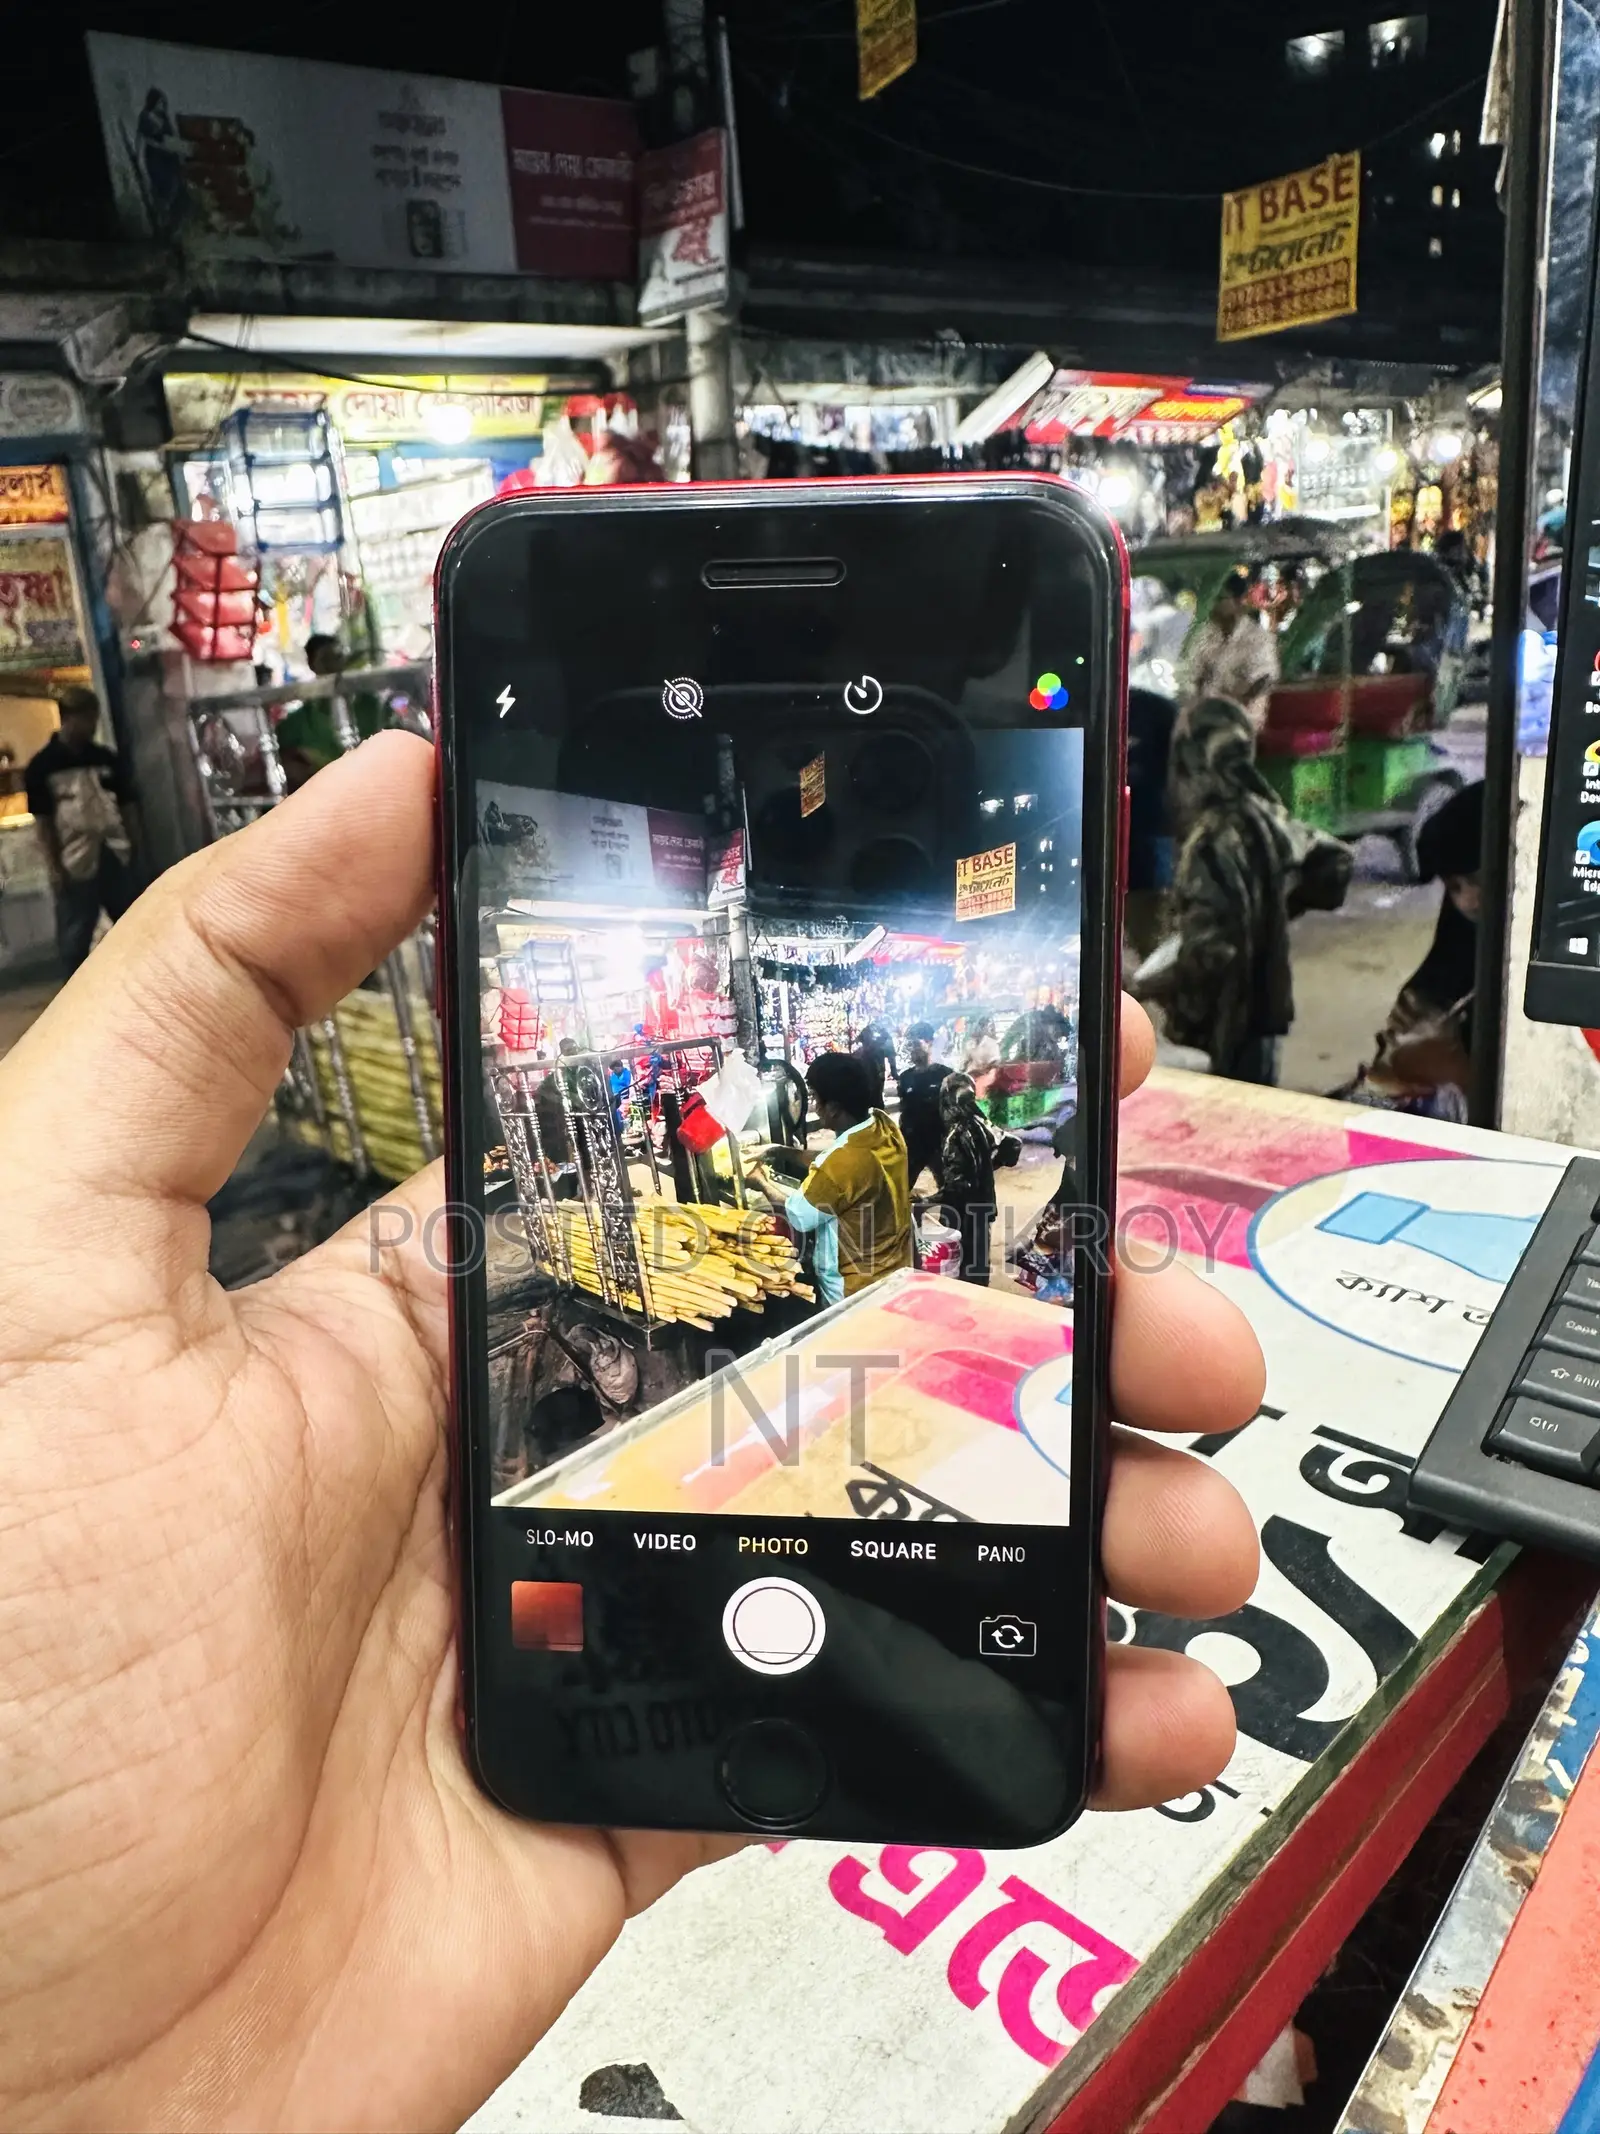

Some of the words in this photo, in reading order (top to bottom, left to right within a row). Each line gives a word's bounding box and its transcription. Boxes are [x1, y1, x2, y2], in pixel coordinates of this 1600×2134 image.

[1223, 192, 1248, 236] IT
[1258, 156, 1355, 224] BASE
[972, 847, 1014, 873] BASE
[526, 1528, 594, 1548] SLO-MO
[633, 1532, 697, 1551] VIDEO
[738, 1536, 809, 1555] PHOTO
[850, 1540, 937, 1560] SQUARE
[977, 1545, 1026, 1562] PANO
